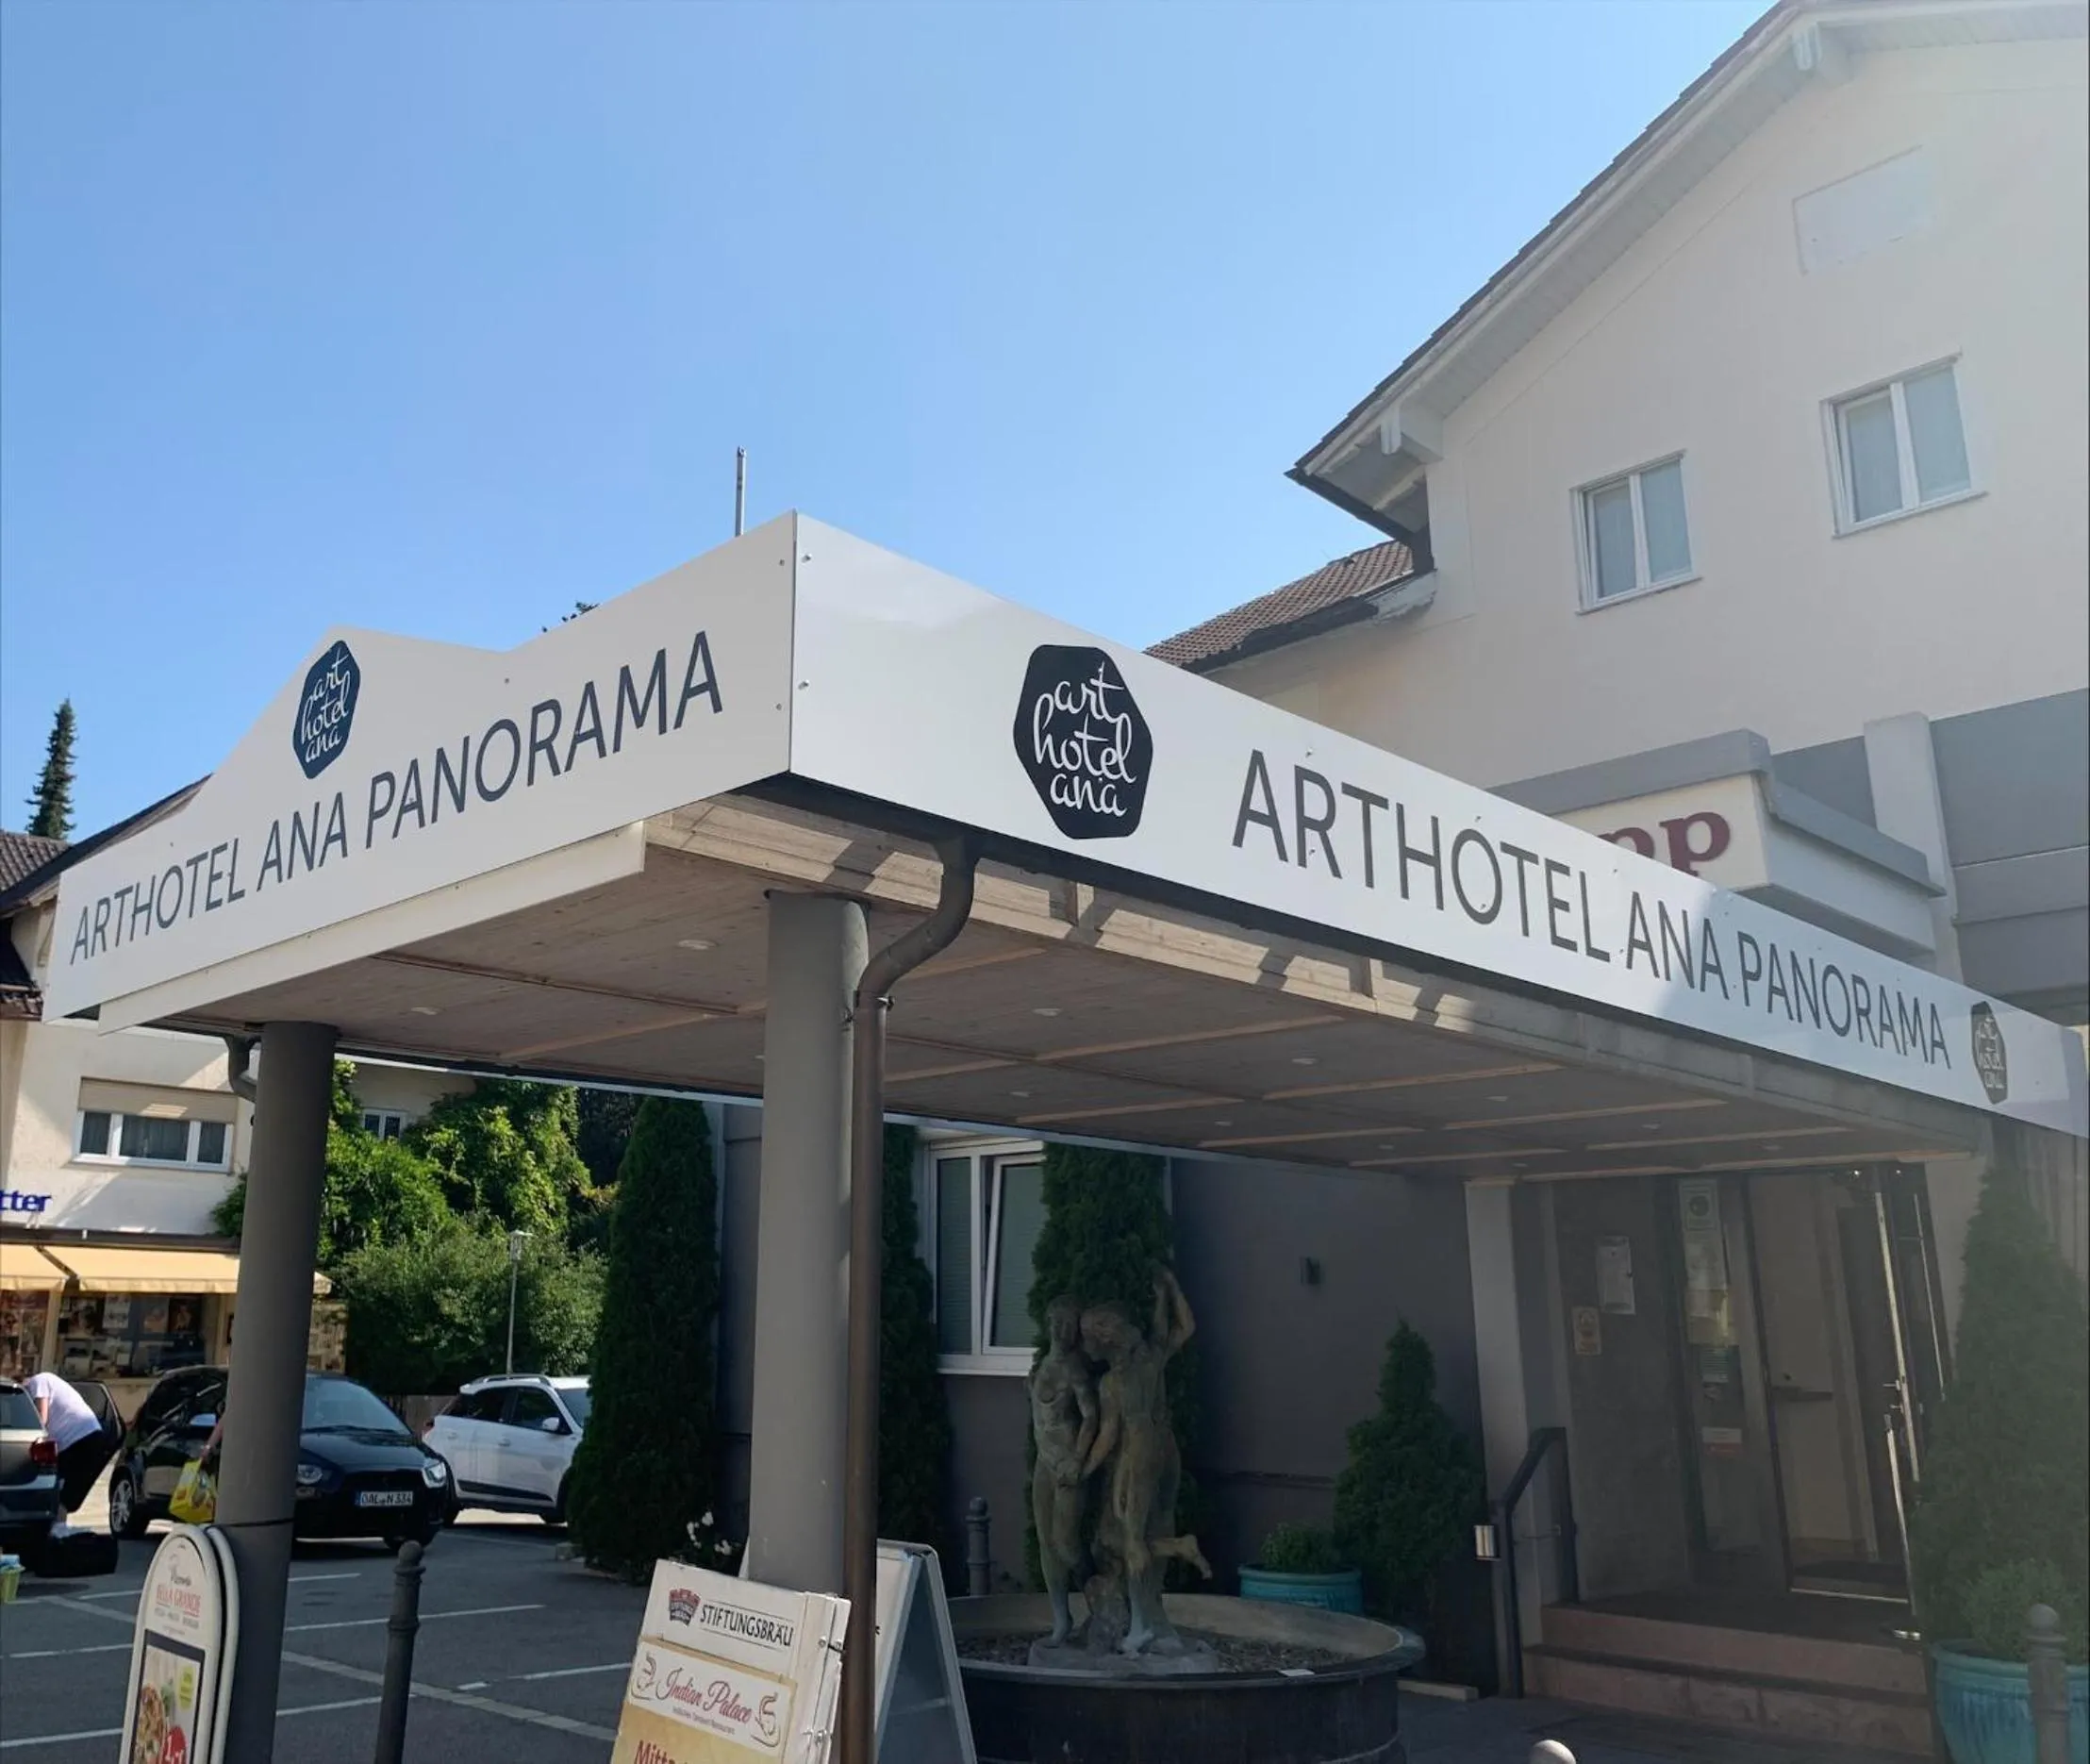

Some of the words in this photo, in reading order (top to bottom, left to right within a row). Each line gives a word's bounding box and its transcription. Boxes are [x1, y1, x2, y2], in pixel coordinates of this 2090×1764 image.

[312, 647, 349, 701] art
[1054, 661, 1124, 721] art
[302, 671, 350, 744] hotel
[306, 725, 342, 763] ana
[1034, 692, 1136, 784] hotel
[70, 838, 245, 965] ARTHOTEL
[257, 791, 348, 891] ANA
[366, 630, 722, 849] PANORAMA
[1050, 772, 1127, 818] ana
[1232, 749, 1610, 963] ARTHOTEL
[1626, 890, 1730, 1000] ANA
[1737, 931, 1951, 1070] PANORAMA
[700, 1604, 794, 1646] STIFTUNGSBRÄU
[655, 1667, 703, 1706] Indian
[703, 1680, 753, 1723] Palace
